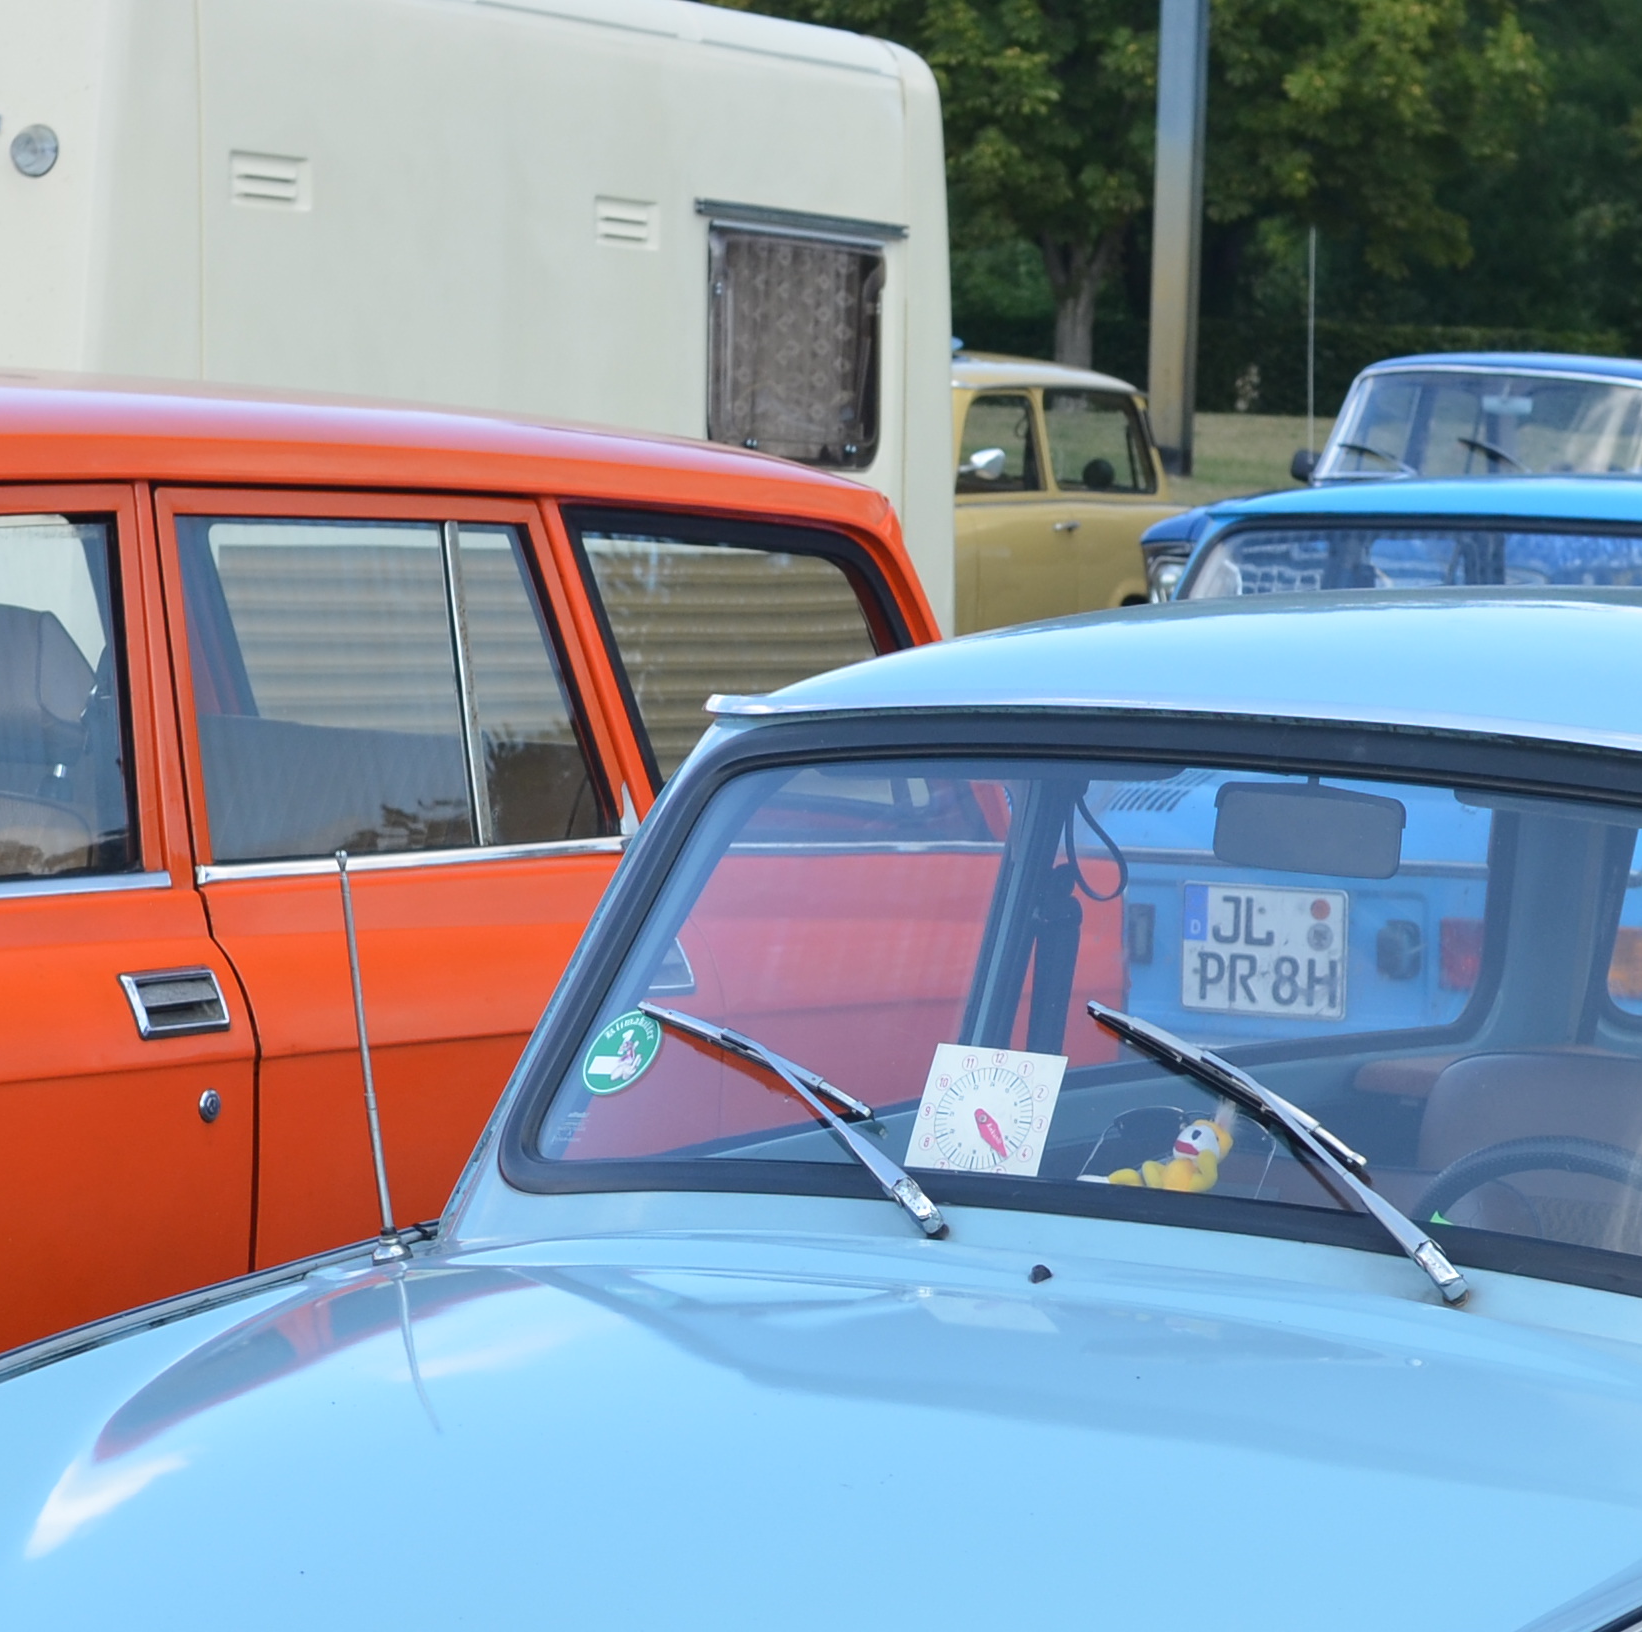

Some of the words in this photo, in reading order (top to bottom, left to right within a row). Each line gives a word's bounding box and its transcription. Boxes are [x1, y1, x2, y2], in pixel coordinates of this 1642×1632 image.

[1212, 895, 1274, 947] JL
[1198, 951, 1257, 1004] PR
[1272, 955, 1338, 1009] 8H
